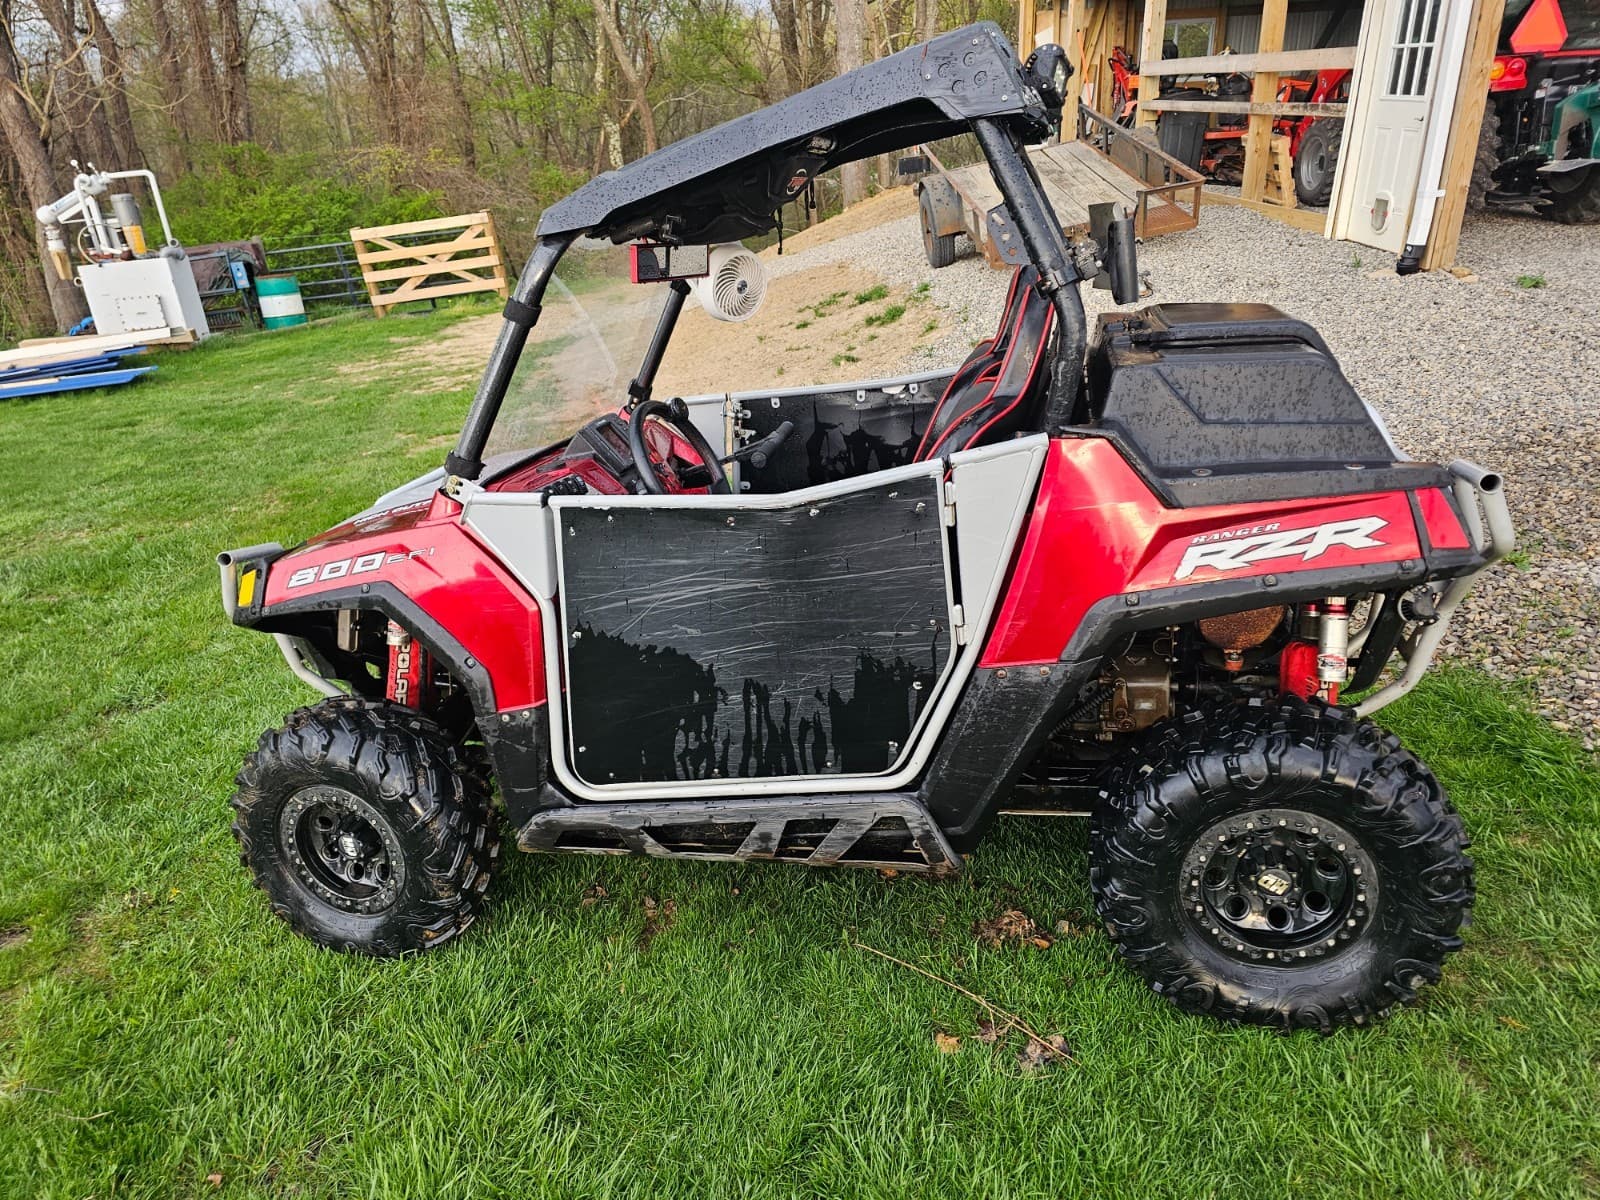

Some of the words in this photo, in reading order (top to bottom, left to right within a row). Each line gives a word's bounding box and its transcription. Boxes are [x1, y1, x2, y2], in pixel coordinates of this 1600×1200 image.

[1173, 515, 1390, 581] RZR
[1192, 522, 1281, 545] RANGER
[287, 550, 386, 589] 800
[386, 547, 436, 564] EFI
